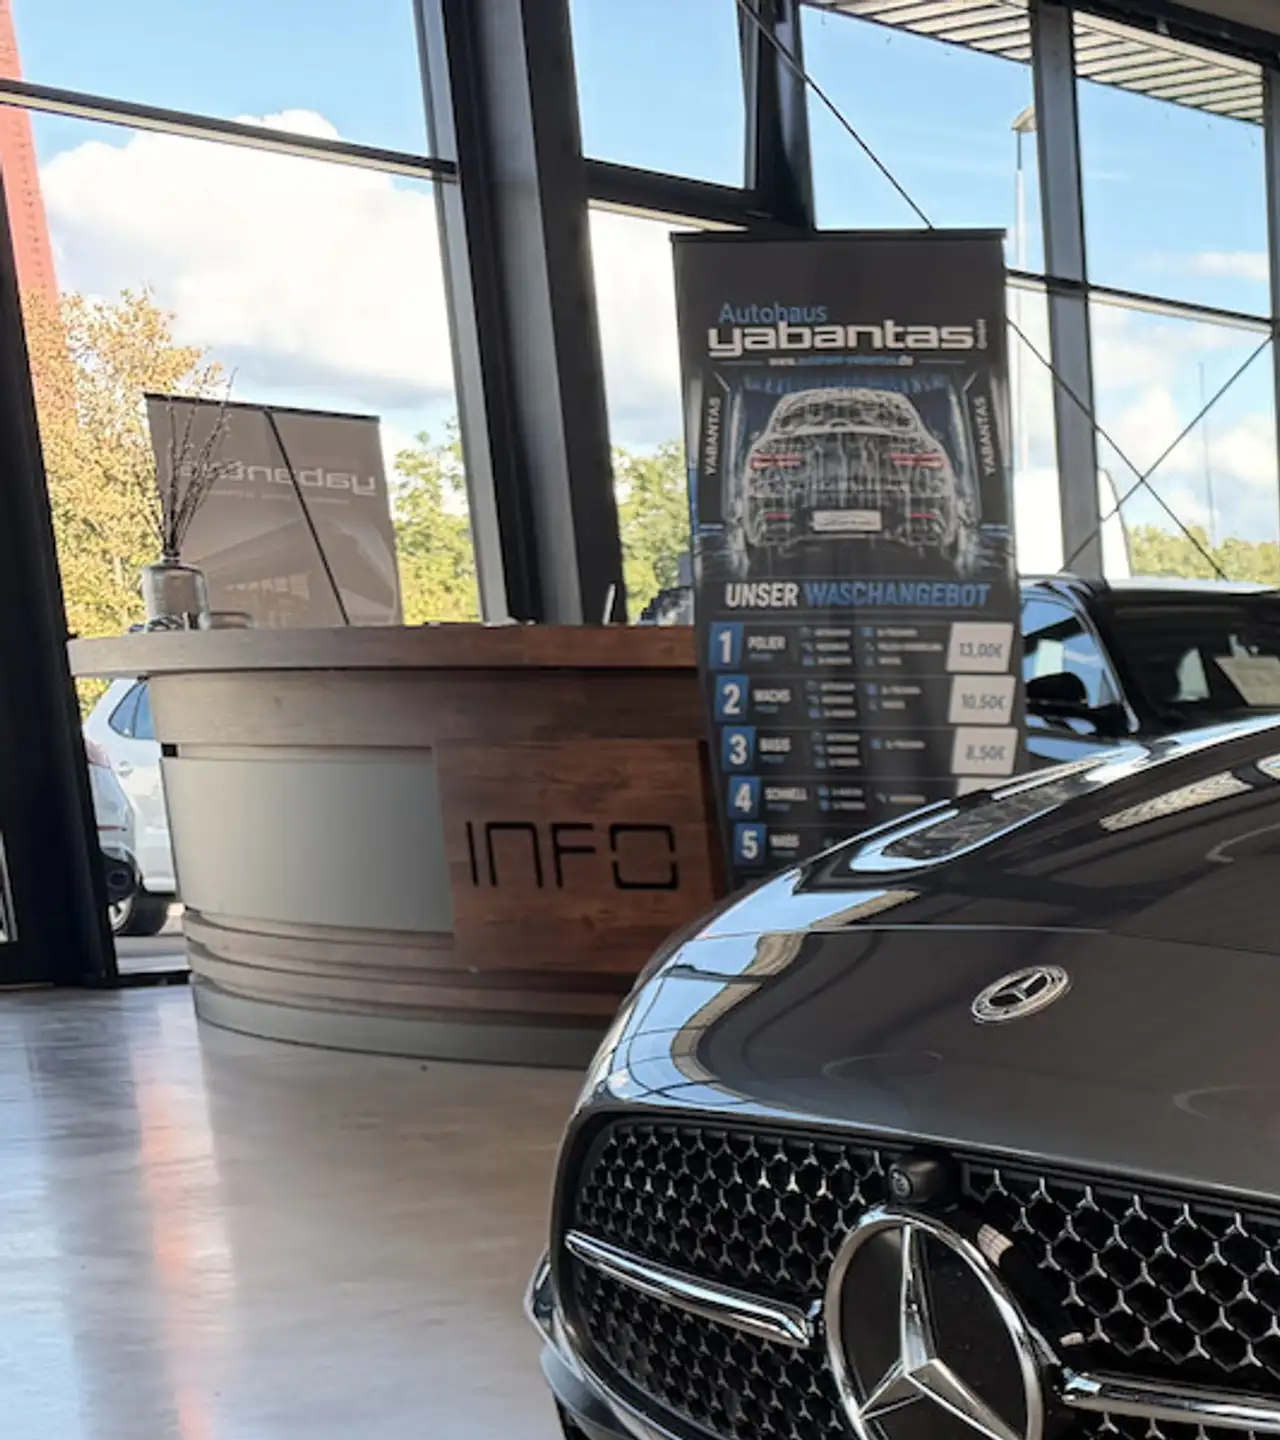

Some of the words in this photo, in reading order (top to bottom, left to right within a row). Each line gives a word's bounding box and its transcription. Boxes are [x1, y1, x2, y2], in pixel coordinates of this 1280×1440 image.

[718, 303, 828, 325] Autohaus
[707, 319, 975, 358] yabantas
[704, 397, 721, 477] YABANTAS
[973, 396, 996, 476] YABANTAS
[725, 583, 799, 608] UNSER
[803, 583, 991, 608] WASCHANGEBOT
[719, 630, 732, 664] 1
[722, 683, 741, 715] 2
[729, 733, 747, 765] 3
[734, 783, 753, 813] 4
[466, 821, 679, 890] INFO
[742, 829, 759, 859] 5
